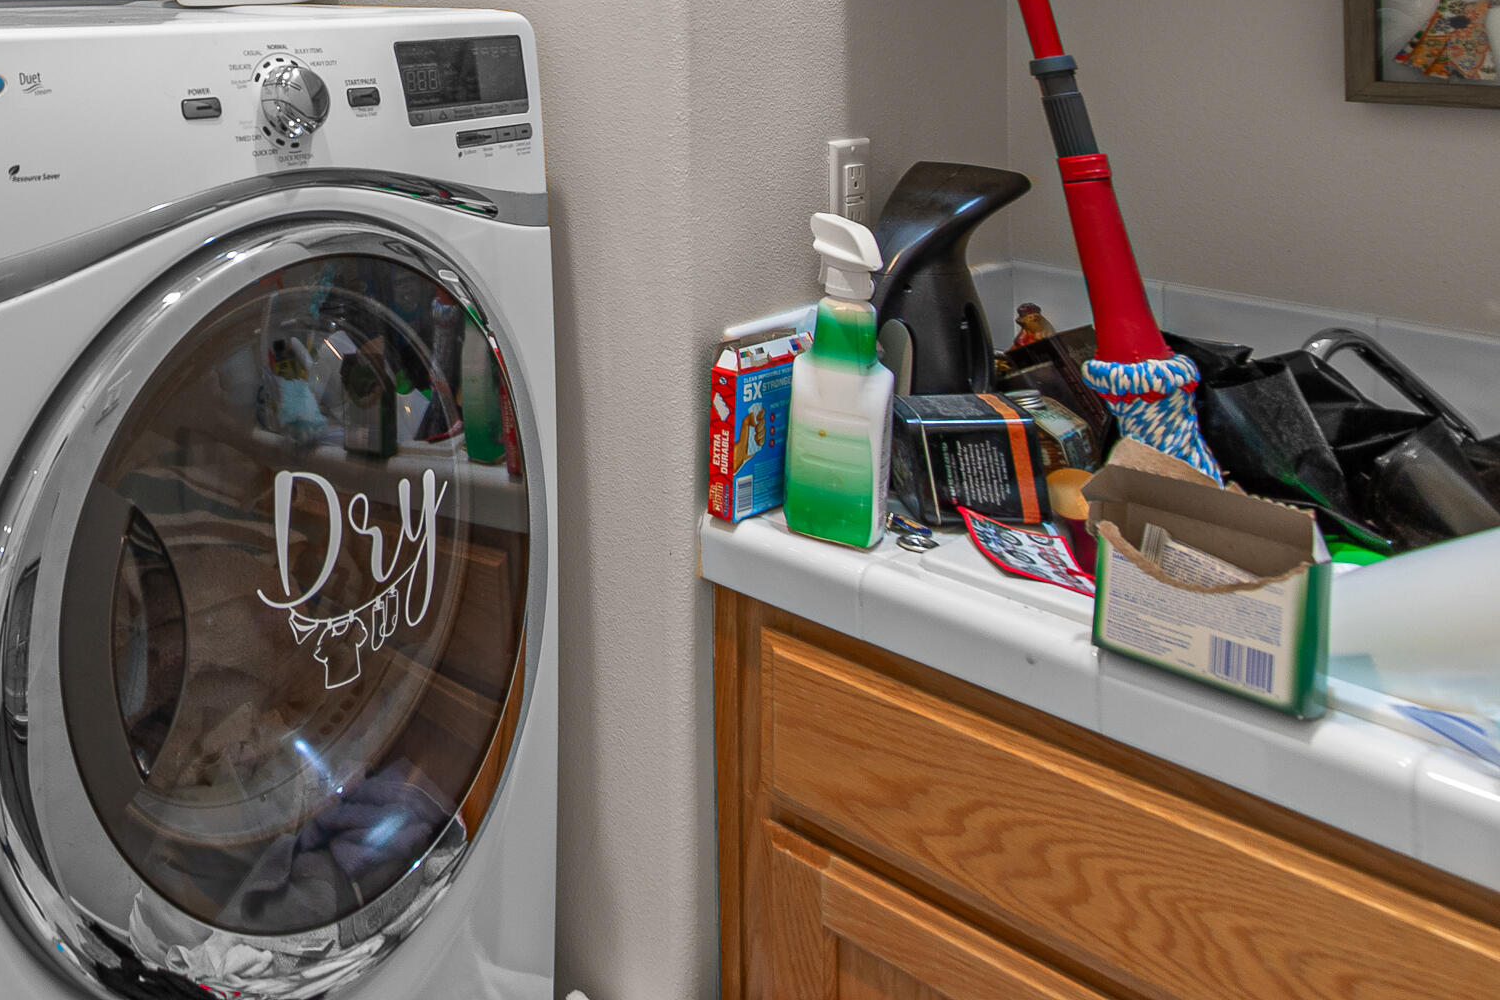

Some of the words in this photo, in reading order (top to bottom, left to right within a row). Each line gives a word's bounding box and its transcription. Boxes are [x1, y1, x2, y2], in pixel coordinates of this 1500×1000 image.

[18, 72, 42, 85] Duet
[187, 87, 211, 96] POWER
[11, 174, 42, 183] Resource
[42, 172, 61, 181] Saver
[742, 380, 763, 403] 5X
[713, 433, 722, 466] EXTRA
[720, 429, 730, 475] DURABLE
[257, 468, 448, 628] Dry
